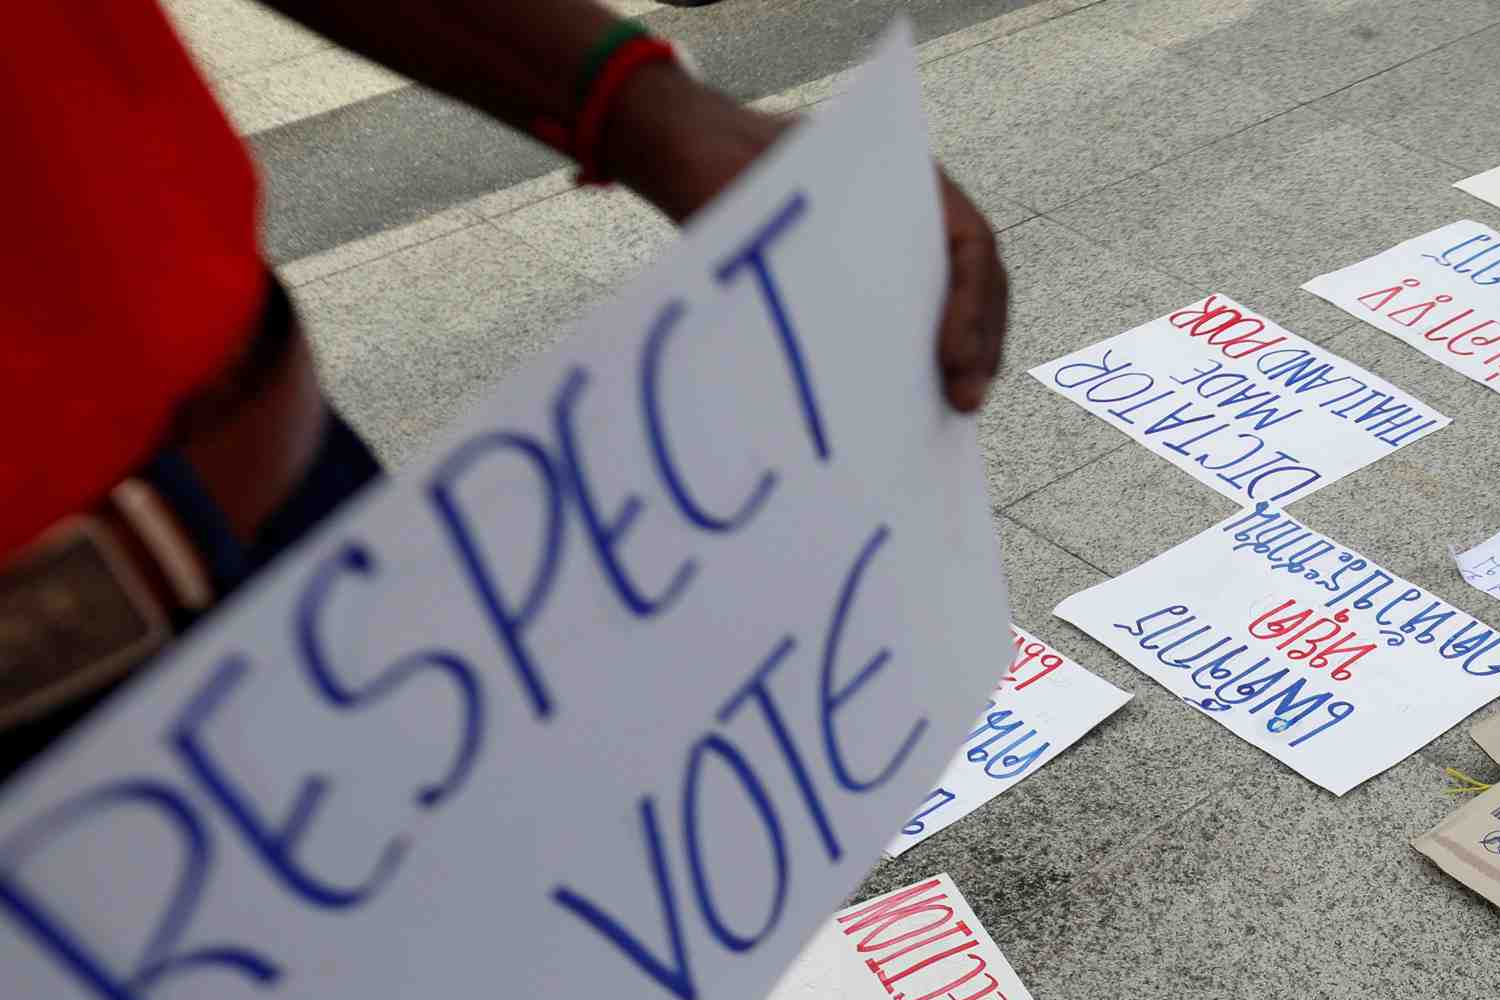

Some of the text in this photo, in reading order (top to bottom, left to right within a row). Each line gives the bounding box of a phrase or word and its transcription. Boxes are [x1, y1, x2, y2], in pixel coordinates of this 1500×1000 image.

[1054, 349, 1322, 506] DICTATOR
[1168, 295, 1438, 447] THAILAND POOR
[1169, 359, 1303, 431] MADE
[1088, 605, 1355, 764] เผด็จการ
[1248, 599, 1378, 681] หยุด
